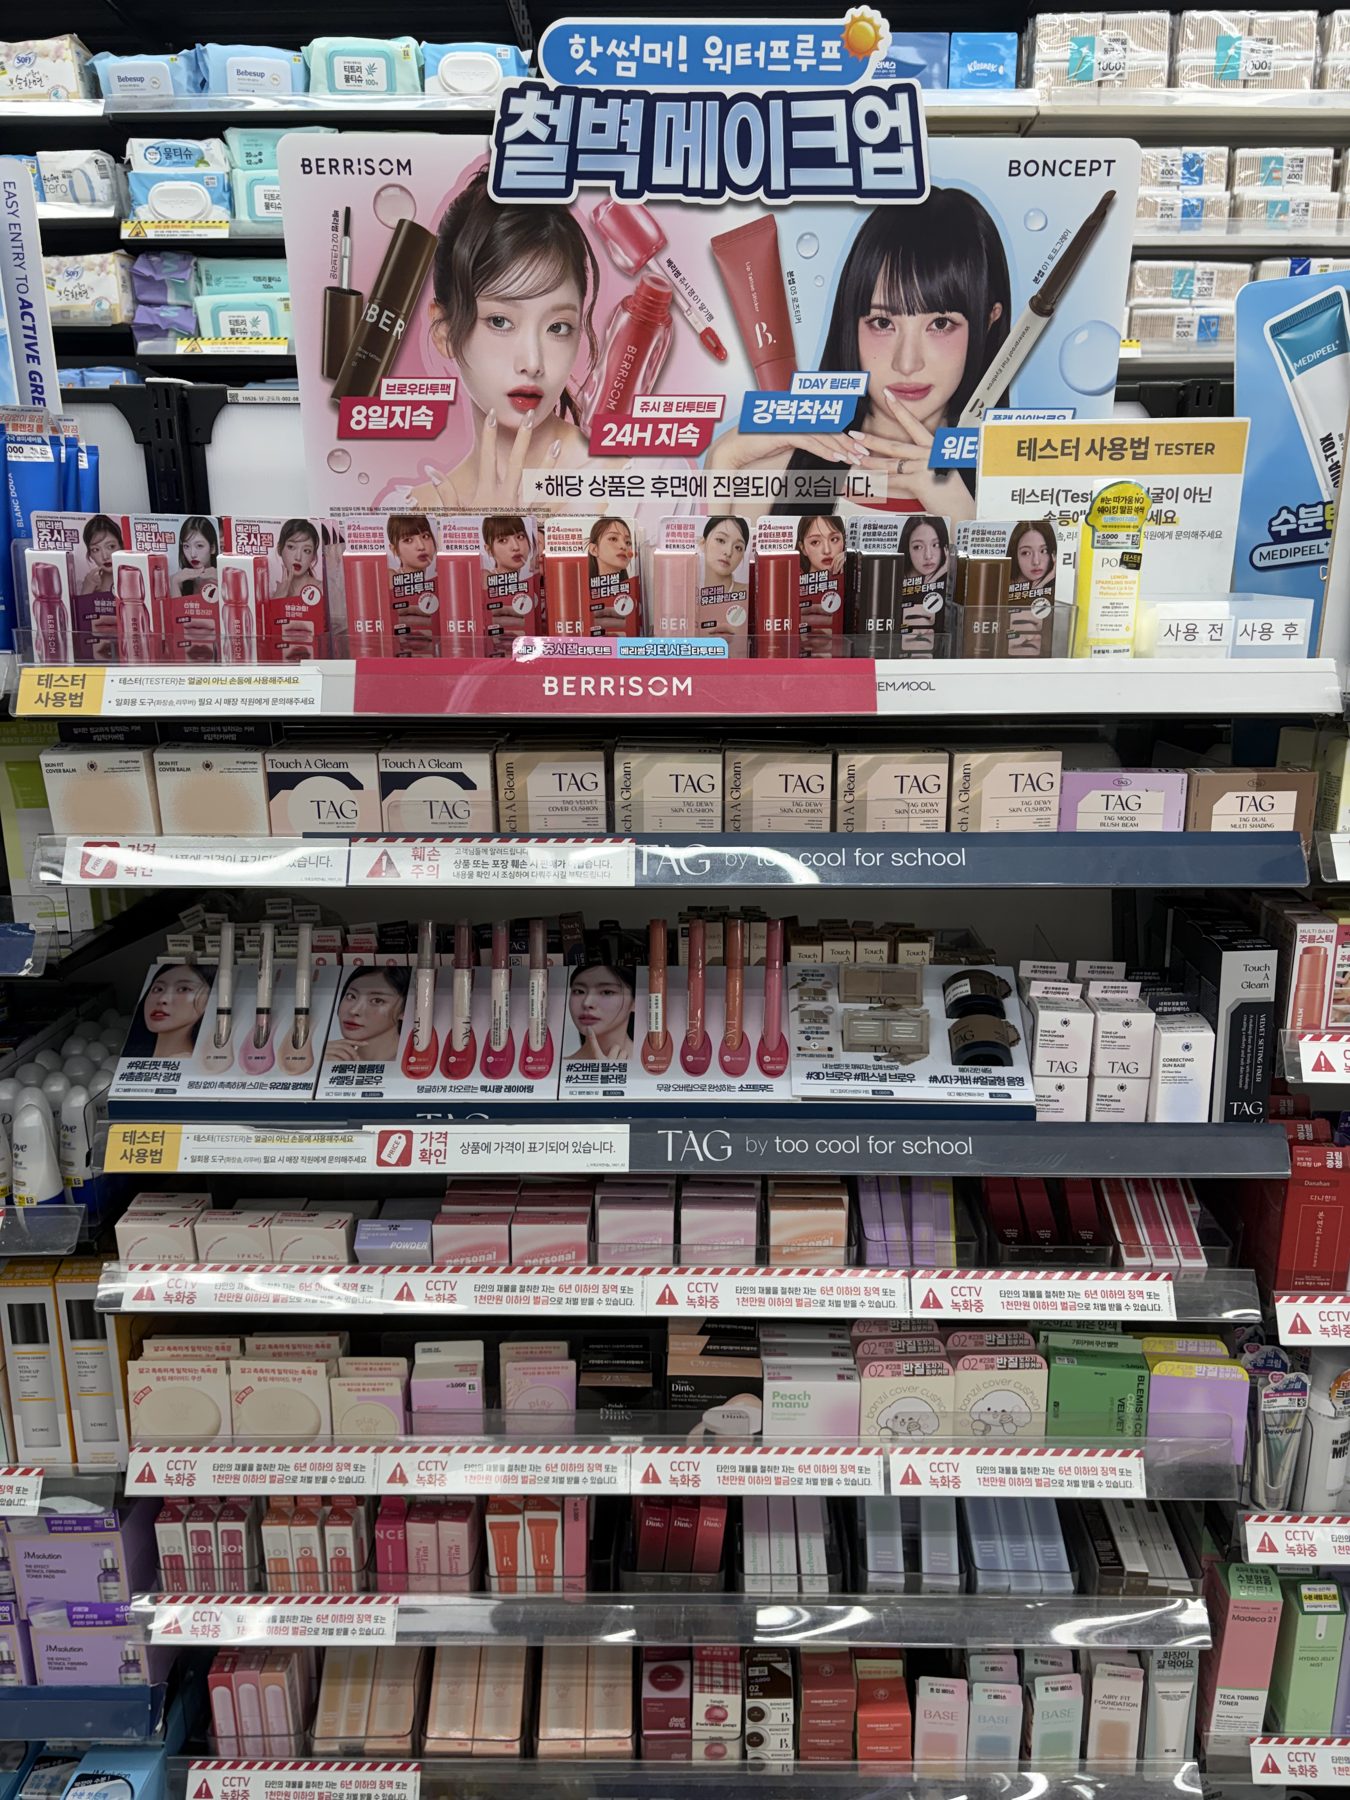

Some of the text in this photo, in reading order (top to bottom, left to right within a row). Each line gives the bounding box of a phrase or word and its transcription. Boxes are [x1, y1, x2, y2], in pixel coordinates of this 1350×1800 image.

[568, 33, 842, 78] 핫썸메! 워터프루프
[236, 68, 265, 79] Bebesup
[343, 64, 362, 74] 티트리
[117, 75, 145, 84] Bebesup
[344, 74, 364, 84] 물티슈
[500, 90, 918, 191] 철벽메이크업
[163, 146, 194, 161] 물티슈
[301, 158, 412, 176] BERRISOM
[1008, 159, 1117, 178] BONCEPT
[44, 181, 68, 194] zero
[2, 181, 46, 408] EASY ENTRY TO ACTIVE GRE
[1293, 344, 1338, 370] MEDIPEEL
[606, 344, 638, 411] BERRISOM
[798, 378, 861, 391] 1DAY 립타투
[385, 383, 451, 396] 브로우타투팩
[639, 401, 718, 414] 쥬시 잼 타투틴트
[752, 398, 844, 425] 강력착색
[350, 404, 434, 431] 8일지속
[600, 422, 701, 447] 24H 지속
[1016, 436, 1216, 462] 테스터 사용법 TESTER
[587, 475, 645, 498] 상품은
[650, 475, 707, 498] 후면에
[712, 475, 789, 499] 진열되어
[793, 475, 875, 499] 있습니다.
[1183, 487, 1212, 504] 아닌
[35, 520, 64, 530] 베리썸
[134, 522, 159, 532] 베리썸
[37, 529, 80, 543] 쥬시잼
[135, 531, 176, 544] 워터시럽
[1174, 529, 1223, 541] 문의해주세요
[38, 541, 75, 551] 타투틴트
[136, 542, 168, 552] 타투틴트
[1258, 544, 1325, 562] MEDIPEEL
[393, 572, 425, 586] 베리썸
[590, 572, 620, 586] 베리썸
[393, 583, 435, 598] 립타투팩
[590, 583, 630, 599] 립타투팩
[700, 585, 725, 595] 베리썸
[700, 591, 747, 605] 유리광립오일
[355, 620, 384, 633] BER
[867, 618, 895, 630] BER
[1163, 623, 1223, 642] 사용 전
[1239, 622, 1300, 641] 사용 후
[36, 673, 87, 689] 테스터
[119, 676, 300, 686] 테스터(TESTER)는 얼굴이 아닌 손등에 사용해주세요
[543, 676, 693, 697] BERRISOM
[34, 692, 84, 709] 사용법
[268, 758, 349, 770] Touch A Gleam
[551, 772, 599, 792] TAG
[894, 773, 942, 795] TAG
[310, 799, 358, 820] TAG
[1101, 794, 1142, 812] TAG
[1235, 795, 1275, 812] TAG
[411, 847, 441, 861] 훼손
[799, 848, 966, 867] cool for school
[410, 863, 440, 879] 주의
[1298, 933, 1335, 945] 주름스틱
[1243, 963, 1271, 972] Touch
[1262, 973, 1270, 981] A
[1240, 981, 1269, 990] Gleam
[160, 1061, 180, 1071] 픽싱
[565, 1062, 628, 1073] #오버립 필수템
[1047, 1060, 1078, 1074] TAG
[565, 1074, 627, 1085] #소프트 블러링
[1229, 1101, 1263, 1116] TAG
[121, 1130, 166, 1146] 테스터
[420, 1131, 448, 1146] 가격
[386, 1139, 401, 1160] PRICE
[459, 1141, 616, 1155] 상품에 가격이 표기되어 있습니다.
[657, 1129, 974, 1162] TAG by too cool for school
[119, 1148, 164, 1164] 사용법
[418, 1149, 448, 1165] 확인
[390, 1241, 428, 1250] POWDER
[425, 1280, 458, 1291] CCTV
[473, 1284, 634, 1295] 타인의 재물을 절취한 자는 6년 이하의 징역 또는
[686, 1282, 719, 1293] CCTV
[685, 1295, 720, 1310] 녹화중
[671, 1383, 695, 1393] Dinto
[771, 1390, 812, 1401] Peach
[1135, 1375, 1146, 1421] BLEMISH
[771, 1401, 810, 1409] manu
[166, 1460, 197, 1471] CCTV
[163, 1473, 197, 1487] 녹화중
[1285, 1530, 1315, 1541] CCTV
[1285, 1543, 1318, 1557] 녹화중
[1231, 1613, 1277, 1623] Madeca 21
[1161, 1650, 1190, 1661] 화장이
[1156, 1659, 1194, 1670] 잘 먹어요
[1093, 1699, 1139, 1708] FOUNDATION
[1102, 1693, 1116, 1701] AIRY
[1219, 1693, 1235, 1701] TECA
[923, 1709, 959, 1721] BASE
